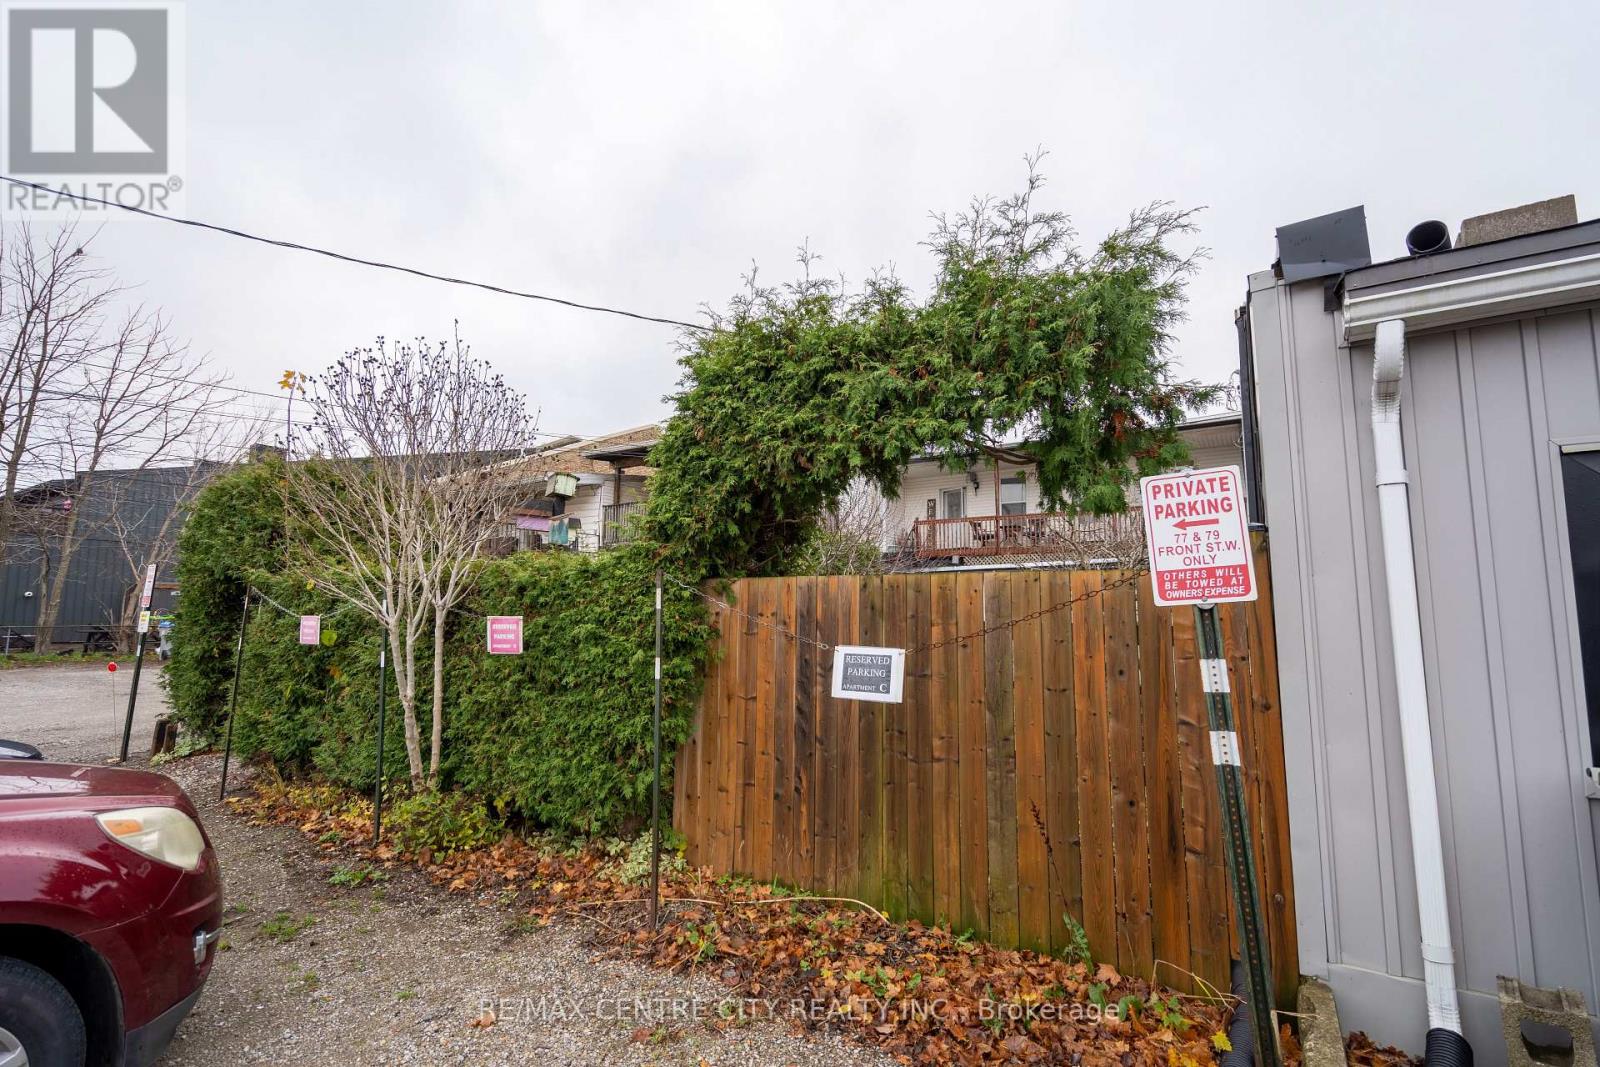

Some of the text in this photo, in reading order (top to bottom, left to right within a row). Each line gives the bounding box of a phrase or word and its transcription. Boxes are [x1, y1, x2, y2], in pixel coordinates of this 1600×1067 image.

[1152, 476, 1230, 500] PRIVATE
[1154, 496, 1233, 520] PARKING
[1174, 530, 1220, 543] 77 & 79
[1158, 543, 1201, 556] FRONT
[1183, 554, 1217, 566] ONLY
[1164, 568, 1242, 580] OTHERS WILL
[1165, 576, 1244, 590] BE TOWED AT
[1166, 586, 1245, 599] OWNERS EXPENSE
[846, 655, 890, 665] RESERVED
[847, 668, 886, 678] PARKING
[880, 684, 888, 692] C
